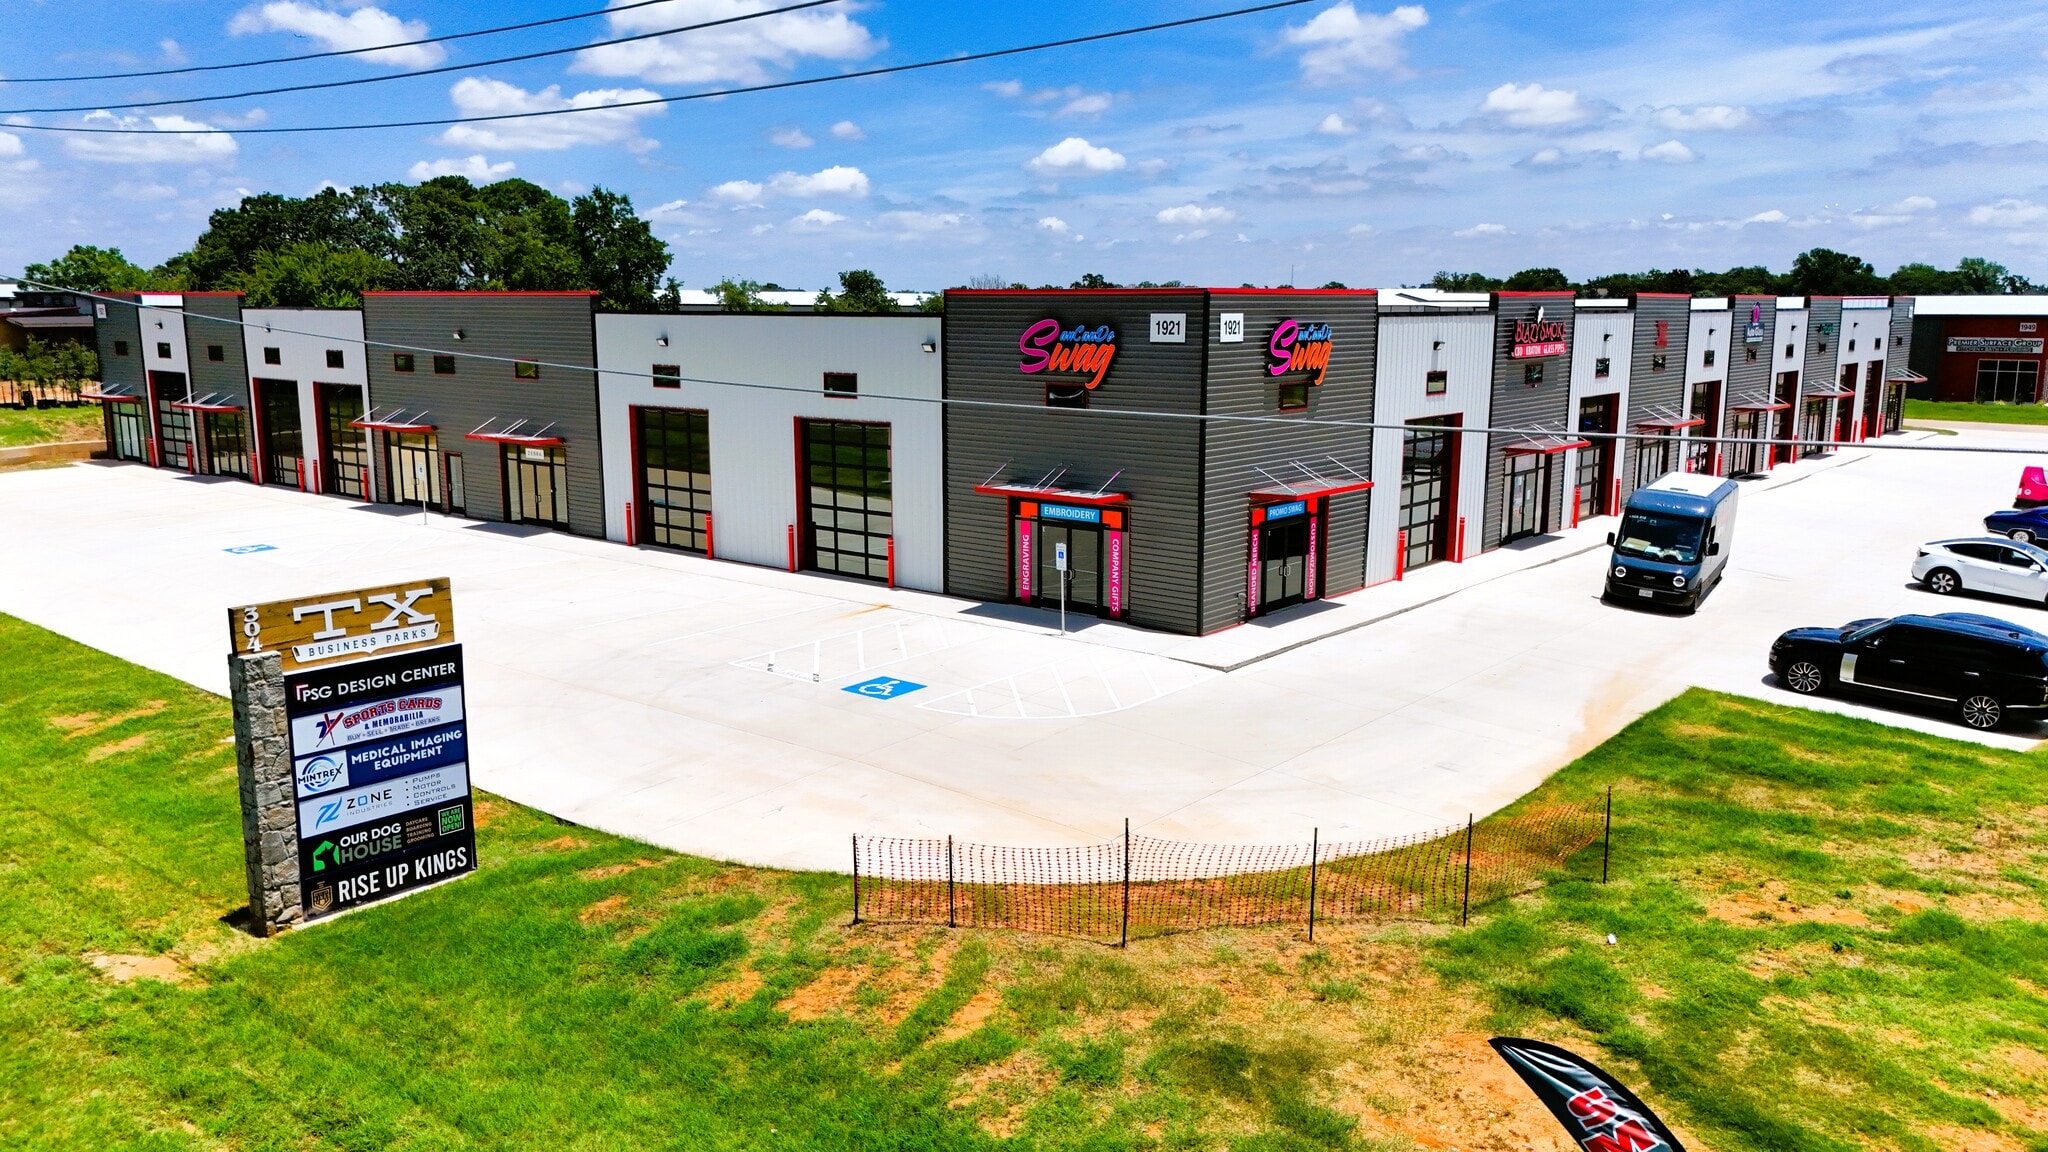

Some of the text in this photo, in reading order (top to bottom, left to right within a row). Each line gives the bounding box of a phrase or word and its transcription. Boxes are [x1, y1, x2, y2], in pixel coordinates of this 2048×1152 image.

[1155, 320, 1181, 335] 1921
[1223, 319, 1241, 335] 1921
[1020, 319, 1116, 389] Swag
[1268, 319, 1332, 385] Swag
[1044, 507, 1095, 519] EMBROIDERY
[1269, 504, 1302, 518] PROMO SWAG
[1112, 538, 1120, 584] COMPANY
[1308, 523, 1316, 595] CUSTOMIZATION
[292, 587, 436, 641] TX
[243, 606, 263, 652] 304
[308, 628, 427, 656] BUSINESS PARKS
[338, 673, 396, 696] DESIGN
[401, 661, 456, 682] CENTER
[343, 697, 442, 729] SPORTS CARDS
[372, 711, 424, 728] MEMORABILIA
[351, 730, 463, 765] MEDICAL IMAGING
[374, 746, 443, 771] EQUIPMENT
[298, 762, 343, 785] MINTREX
[412, 773, 441, 783] PUMPS
[413, 780, 442, 791] MOTOR
[413, 784, 456, 799] CONTROLS
[346, 789, 393, 810] ZONE
[414, 793, 448, 806] SERVICE
[346, 802, 393, 817] INDUSTRIES
[451, 807, 461, 815] ARE
[405, 817, 428, 827] DAYCARE
[441, 813, 461, 826] NOW
[442, 821, 462, 832] OPEN!
[340, 823, 401, 848] OUR DOG
[407, 828, 432, 838] TRAINING
[407, 833, 435, 844] GROOMING
[342, 835, 402, 864] HOUSE
[338, 847, 467, 902] RISE UP KINGS
